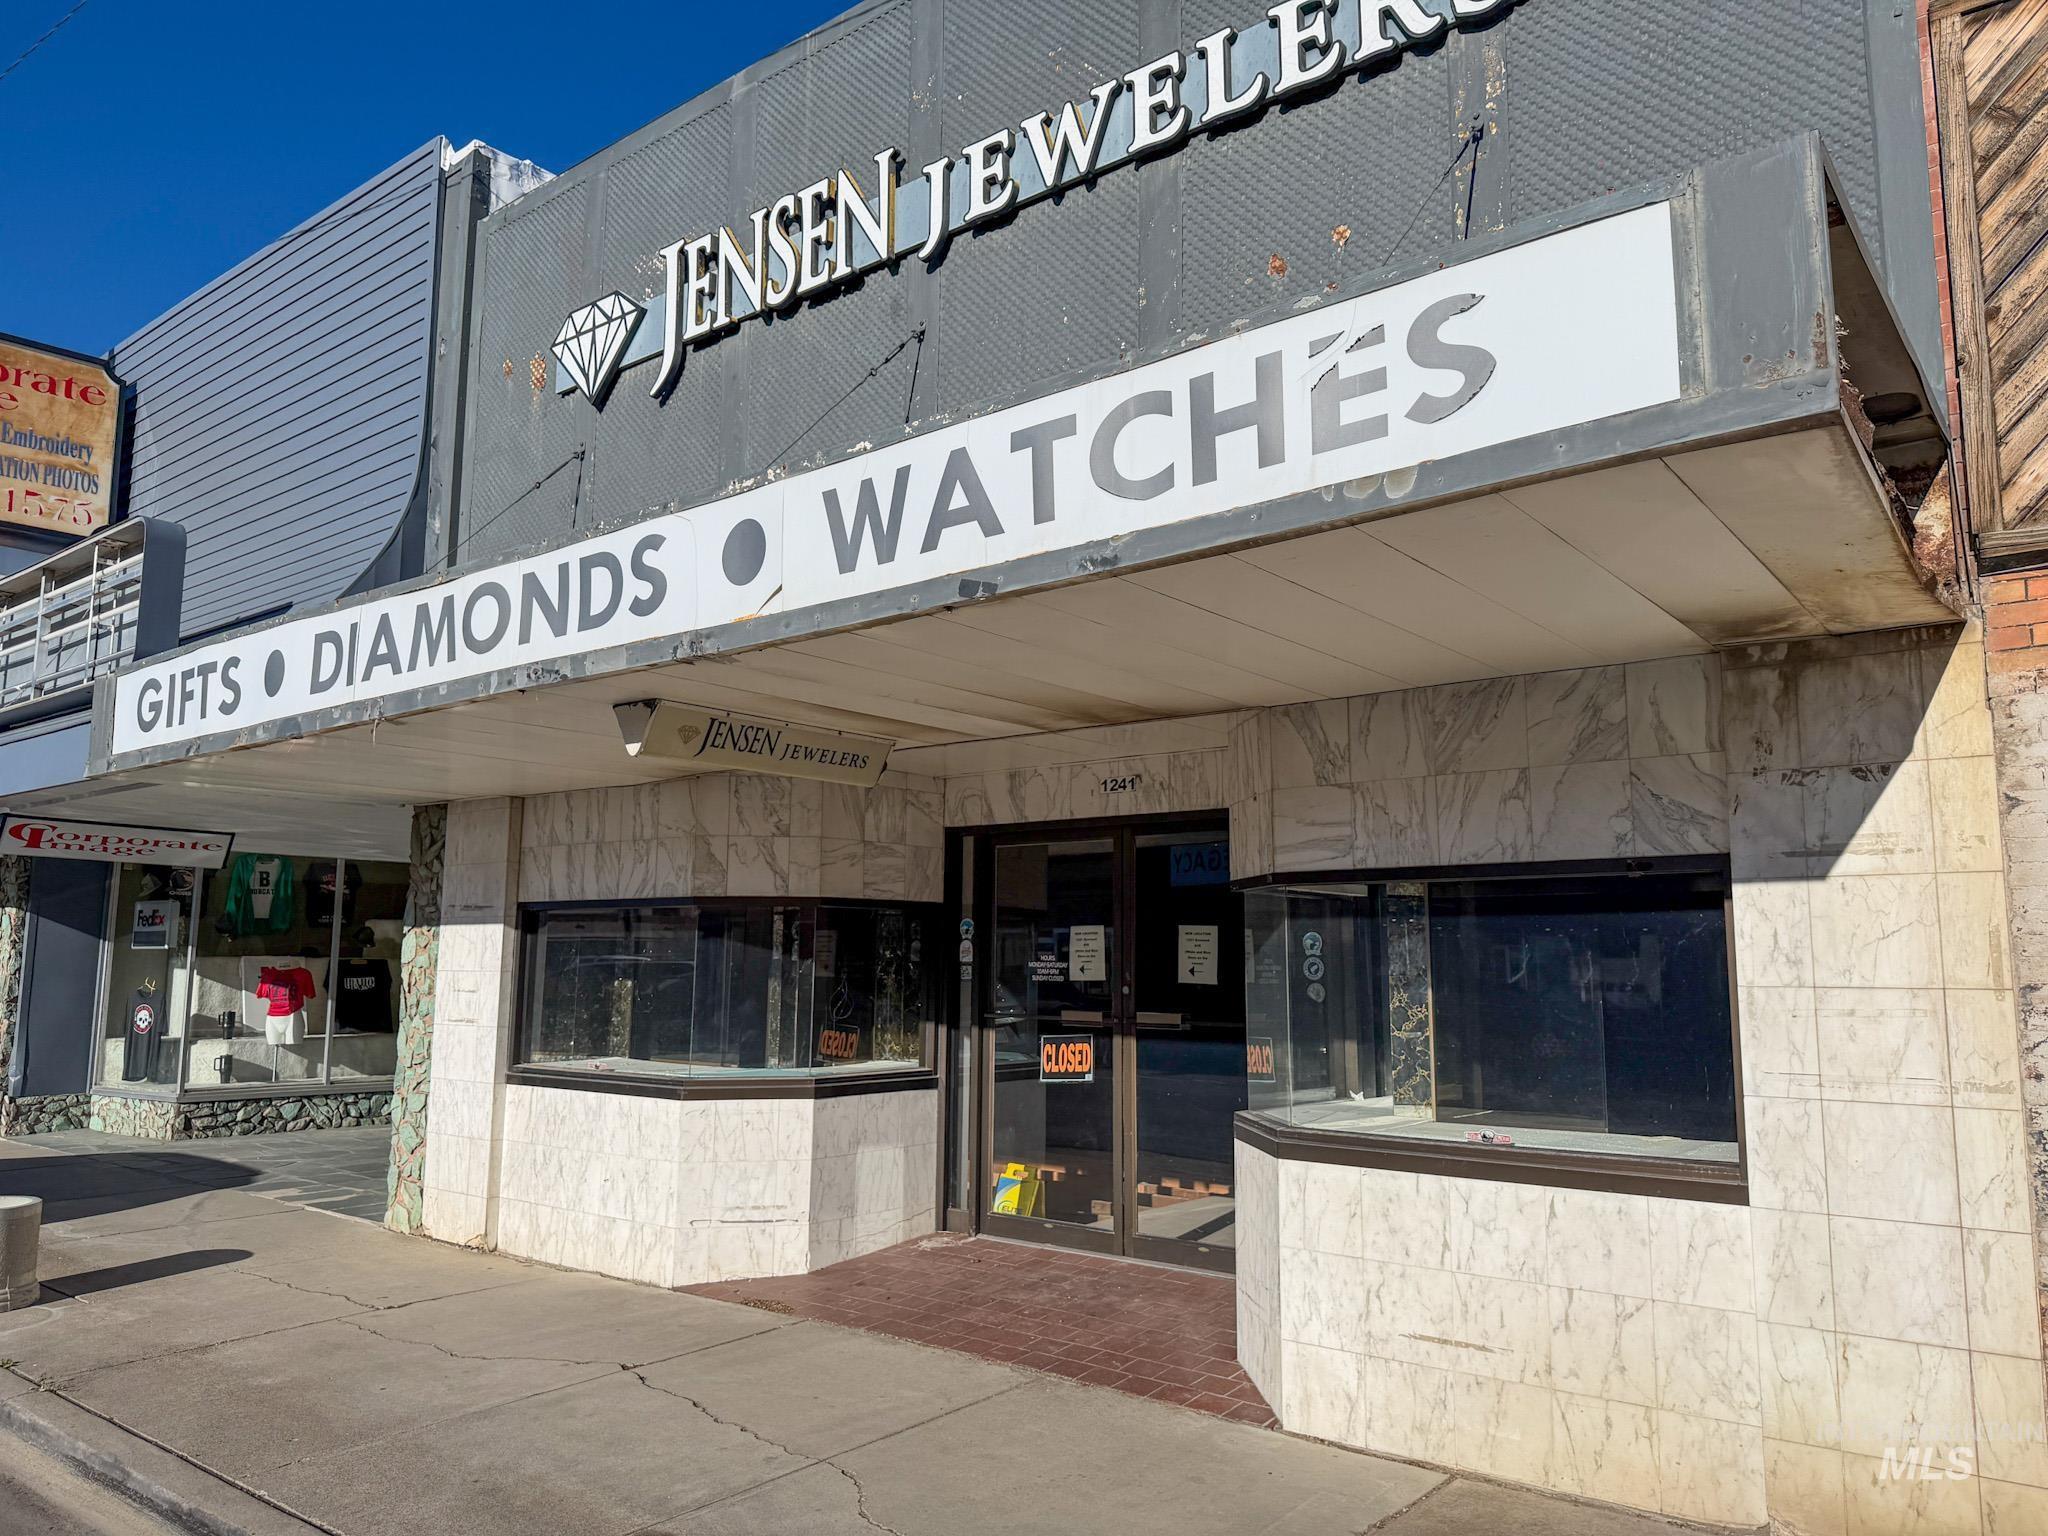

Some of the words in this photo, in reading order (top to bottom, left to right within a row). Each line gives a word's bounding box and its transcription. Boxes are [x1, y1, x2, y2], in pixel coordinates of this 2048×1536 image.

[649, 147, 902, 400] JENSEN
[917, 0, 1512, 262] JEWELER
[1, 421, 94, 466] Embroidery
[821, 292, 1498, 575] WATCHES
[43, 463, 99, 495] PHOTOS
[7, 489, 93, 526] 1575
[308, 533, 668, 696] DIAMONDS
[136, 655, 242, 734] GIFTS
[694, 717, 783, 757] JENSEN
[779, 743, 870, 769] JEWELERS
[1100, 777, 1135, 792] 1241
[8, 823, 224, 852] Corporate
[24, 827, 156, 857] Image
[258, 871, 271, 888] B
[137, 908, 166, 927] FedEx
[1043, 1042, 1092, 1073] CLOSED
